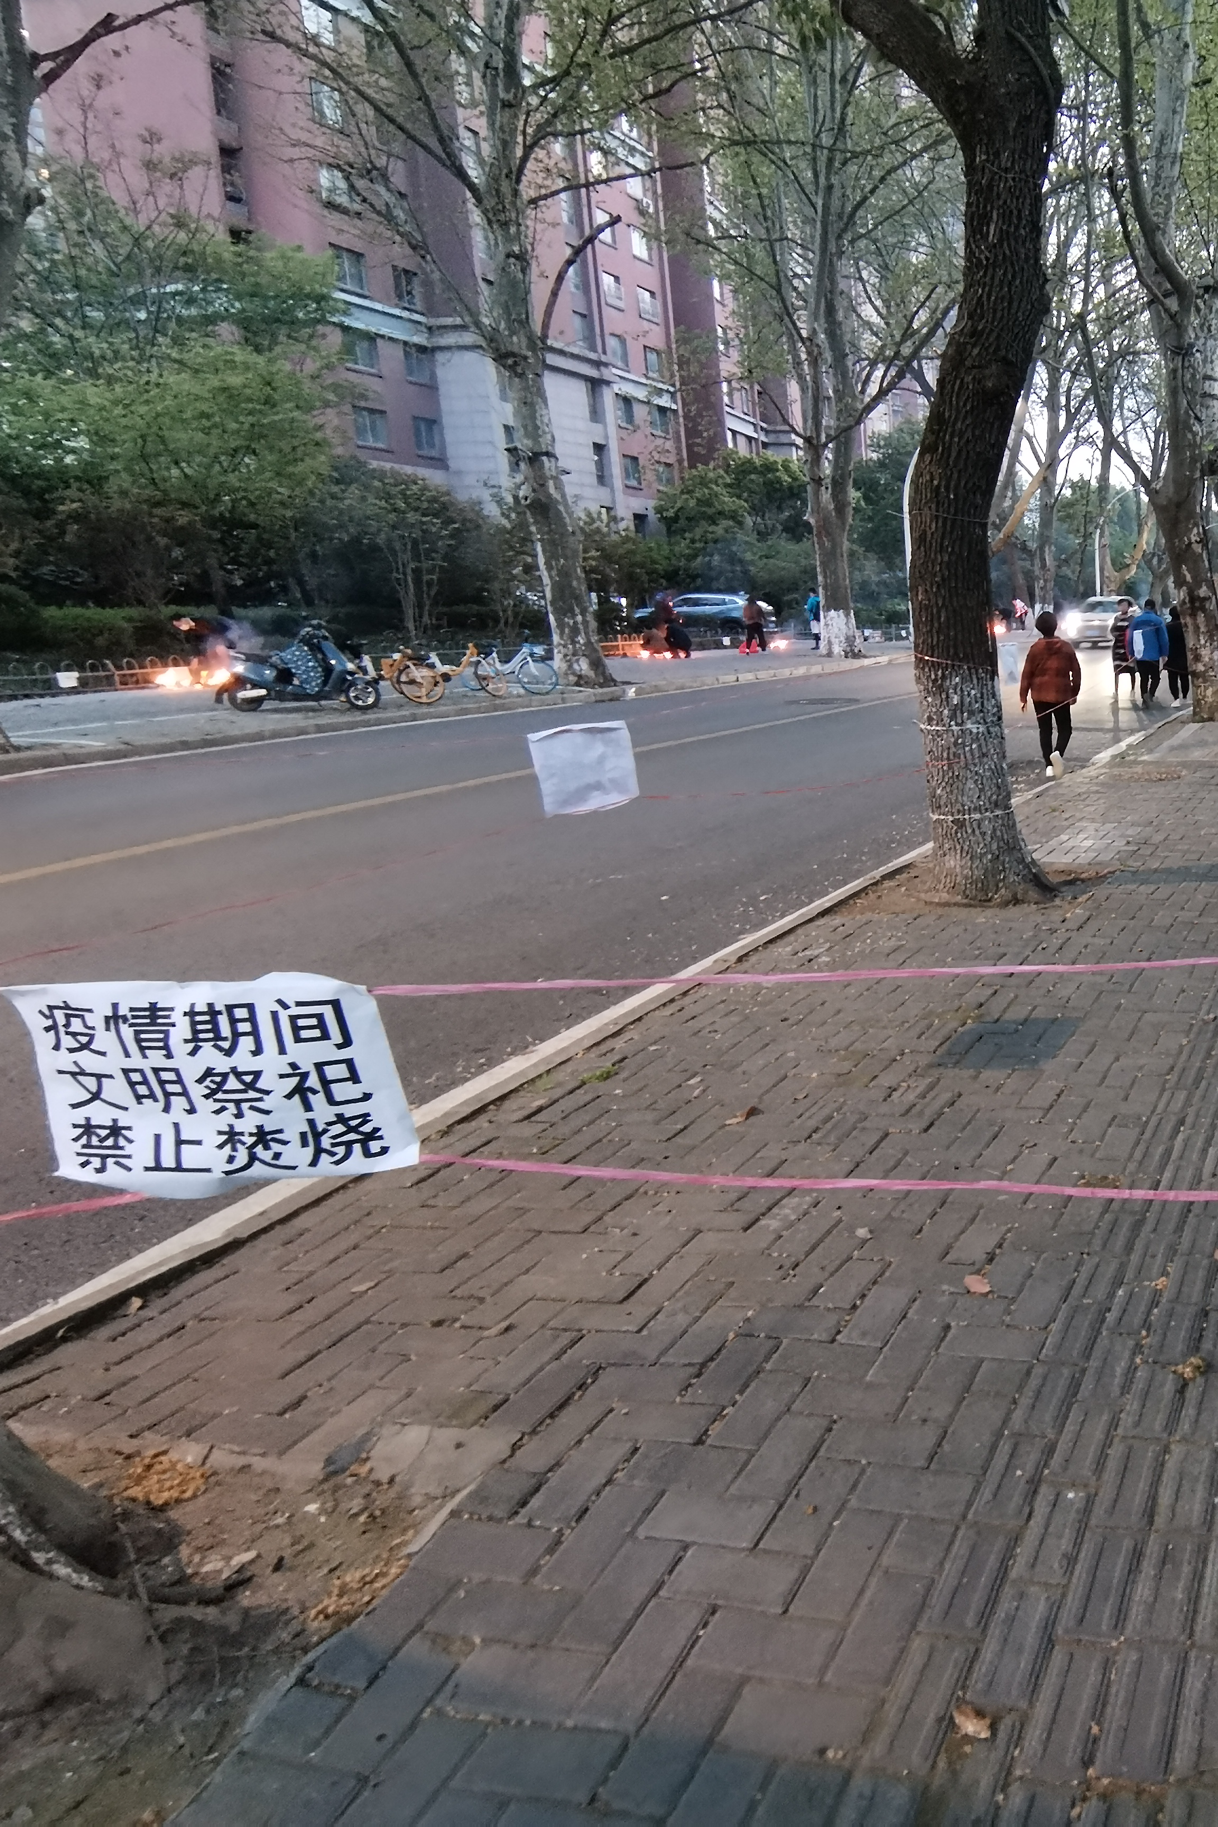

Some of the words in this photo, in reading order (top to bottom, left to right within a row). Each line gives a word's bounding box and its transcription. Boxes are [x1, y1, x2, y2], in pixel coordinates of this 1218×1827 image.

[38, 998, 353, 1059] 疫情期间
[56, 1057, 373, 1119] 文明祭祀
[71, 1112, 390, 1176] 禁止焚烧
